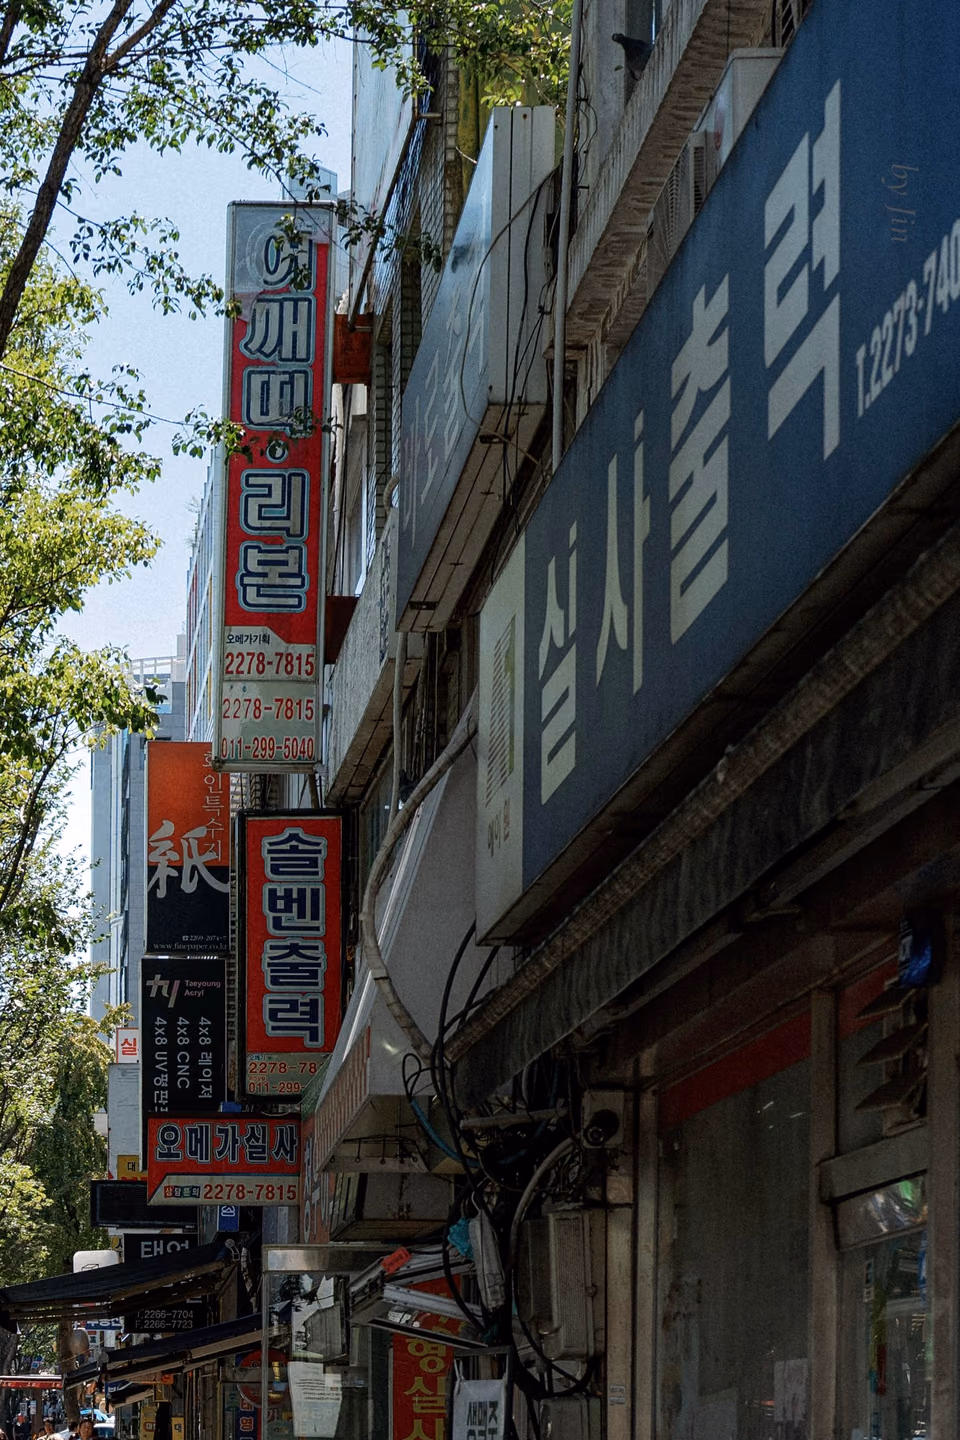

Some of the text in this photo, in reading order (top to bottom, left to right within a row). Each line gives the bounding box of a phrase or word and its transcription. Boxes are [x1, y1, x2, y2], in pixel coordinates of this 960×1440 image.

[539, 78, 840, 806] 실사출력
[226, 633, 270, 645] 오메가기획
[224, 652, 315, 676] 2278-7815
[222, 698, 314, 720] 2278-7815
[220, 737, 315, 760] 011-299-5040
[147, 819, 230, 899] 紙
[184, 979, 221, 988] Taeyoung
[184, 989, 204, 997] Acryl
[121, 1038, 137, 1055] 실
[177, 1051, 190, 1089] CNC
[198, 1052, 213, 1098] 레이저
[248, 1062, 321, 1074] 2278-78
[248, 1082, 306, 1093] 011-299-
[155, 1122, 300, 1166] 오메가실사
[164, 1184, 297, 1200] 상담문의 2278-7815
[135, 1320, 194, 1329] F.2266-7723
